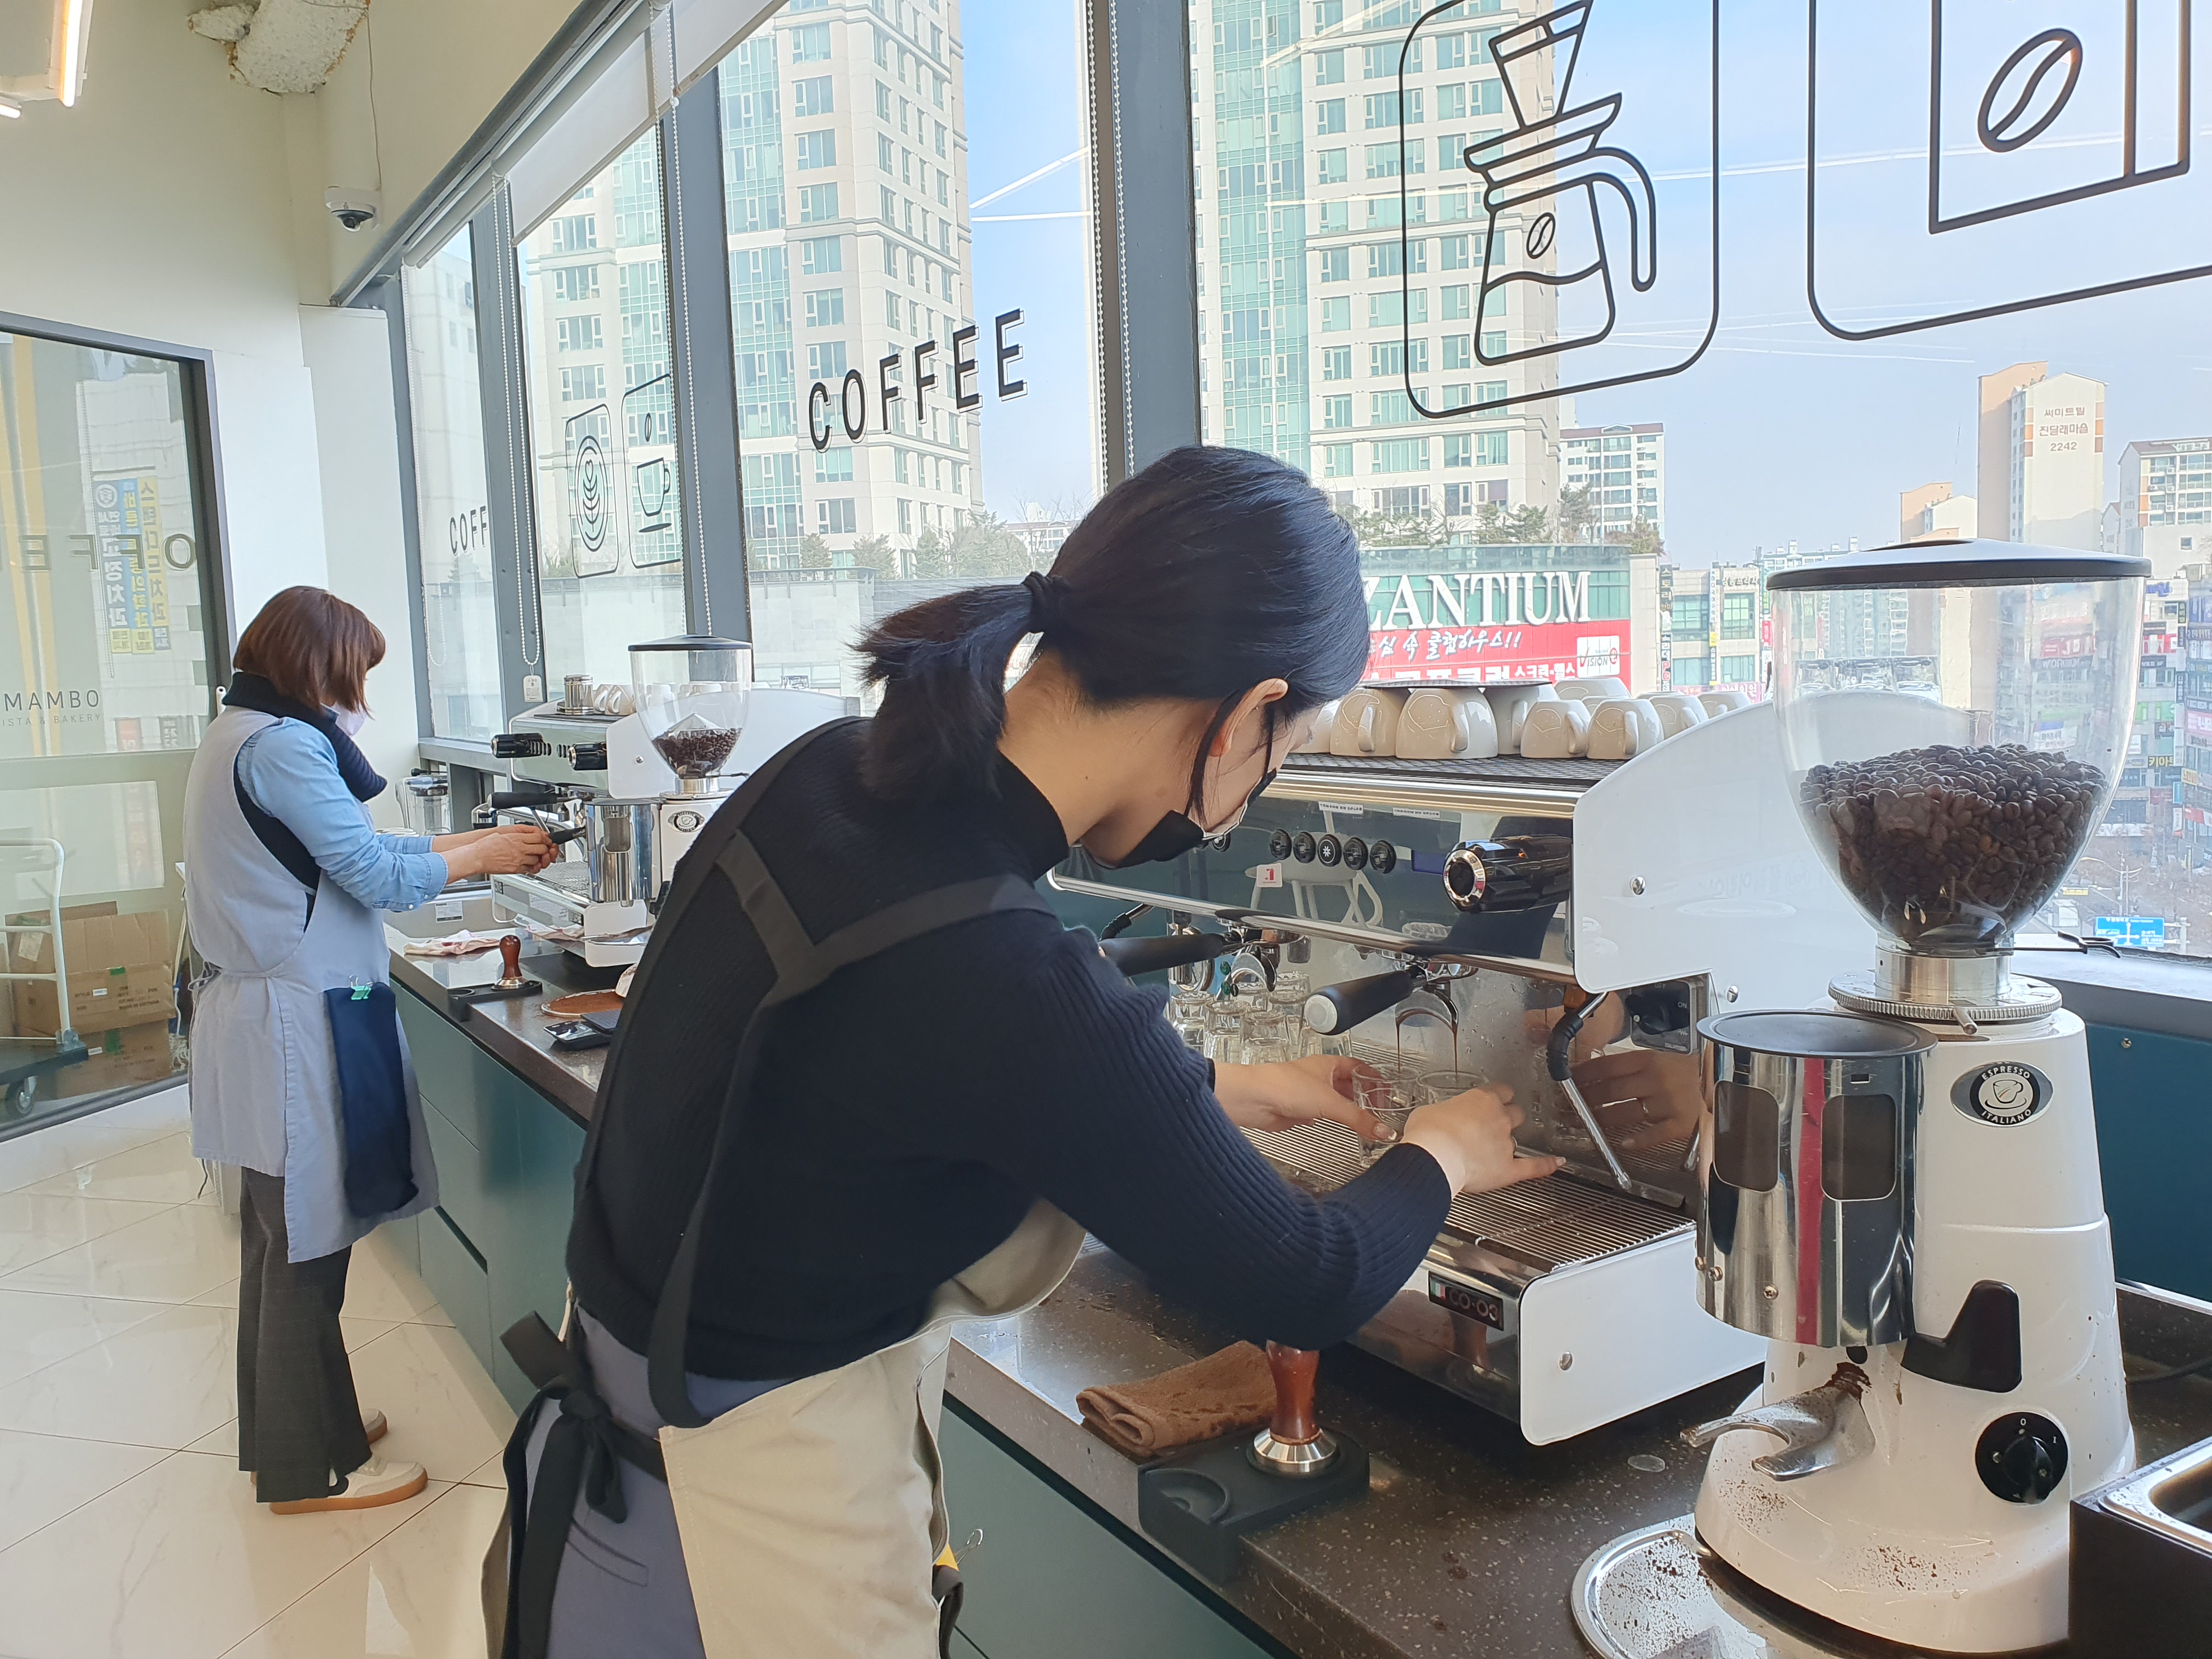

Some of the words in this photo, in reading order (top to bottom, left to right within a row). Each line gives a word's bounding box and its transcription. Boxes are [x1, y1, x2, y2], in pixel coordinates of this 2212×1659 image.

[809, 307, 1028, 453] COFFEE
[2039, 423, 2089, 437] 진달래마을
[2050, 442, 2077, 452] 2242
[449, 505, 488, 556] COFF
[1661, 568, 1672, 601] 스토리
[1370, 635, 1398, 658] 심
[1426, 629, 1522, 662] 클럽하우스!!
[1579, 647, 1608, 667] VISION
[4, 690, 100, 712] MAMBO
[40, 716, 46, 724] &
[54, 713, 100, 724] BAKERY
[1982, 1065, 2030, 1081] ESPRESSO
[1981, 1109, 2032, 1124] ITALIANO
